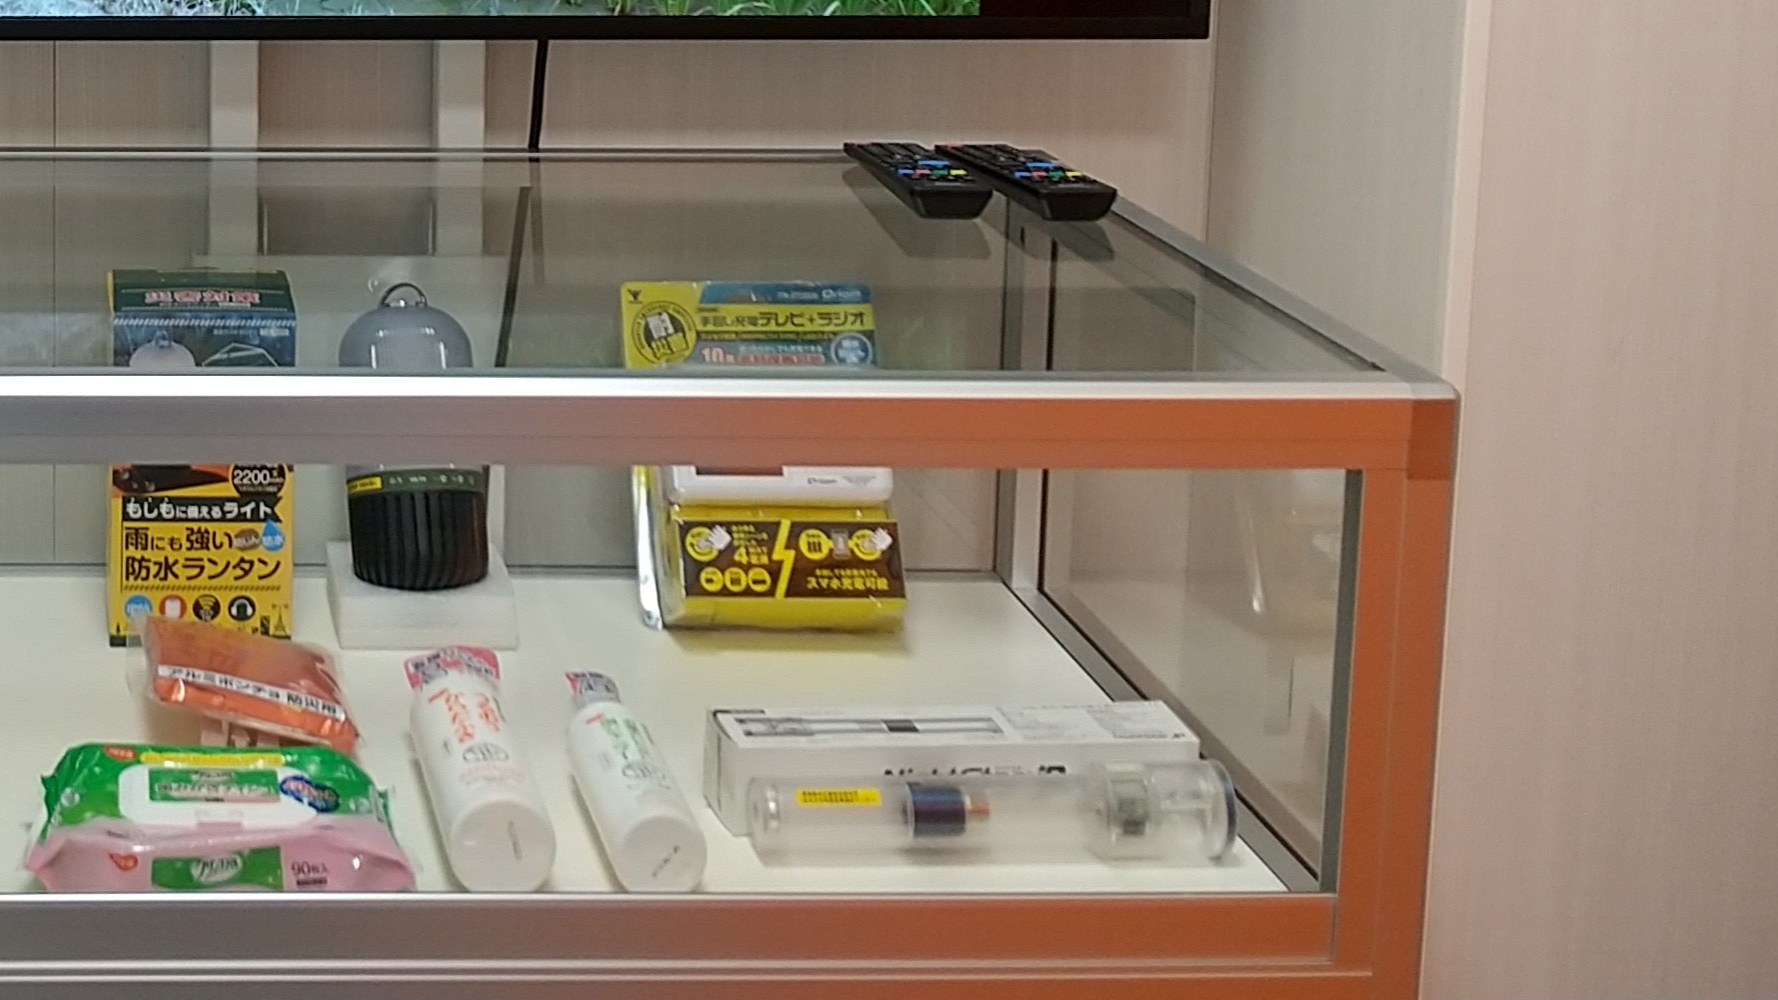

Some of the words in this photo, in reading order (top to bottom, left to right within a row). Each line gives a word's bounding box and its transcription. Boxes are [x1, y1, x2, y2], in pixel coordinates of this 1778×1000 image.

[234, 470, 271, 485] 2200
[126, 497, 272, 519] もしもに備えるライト
[125, 527, 233, 551] 雨にも強い
[125, 556, 281, 582] 防水ランタン
